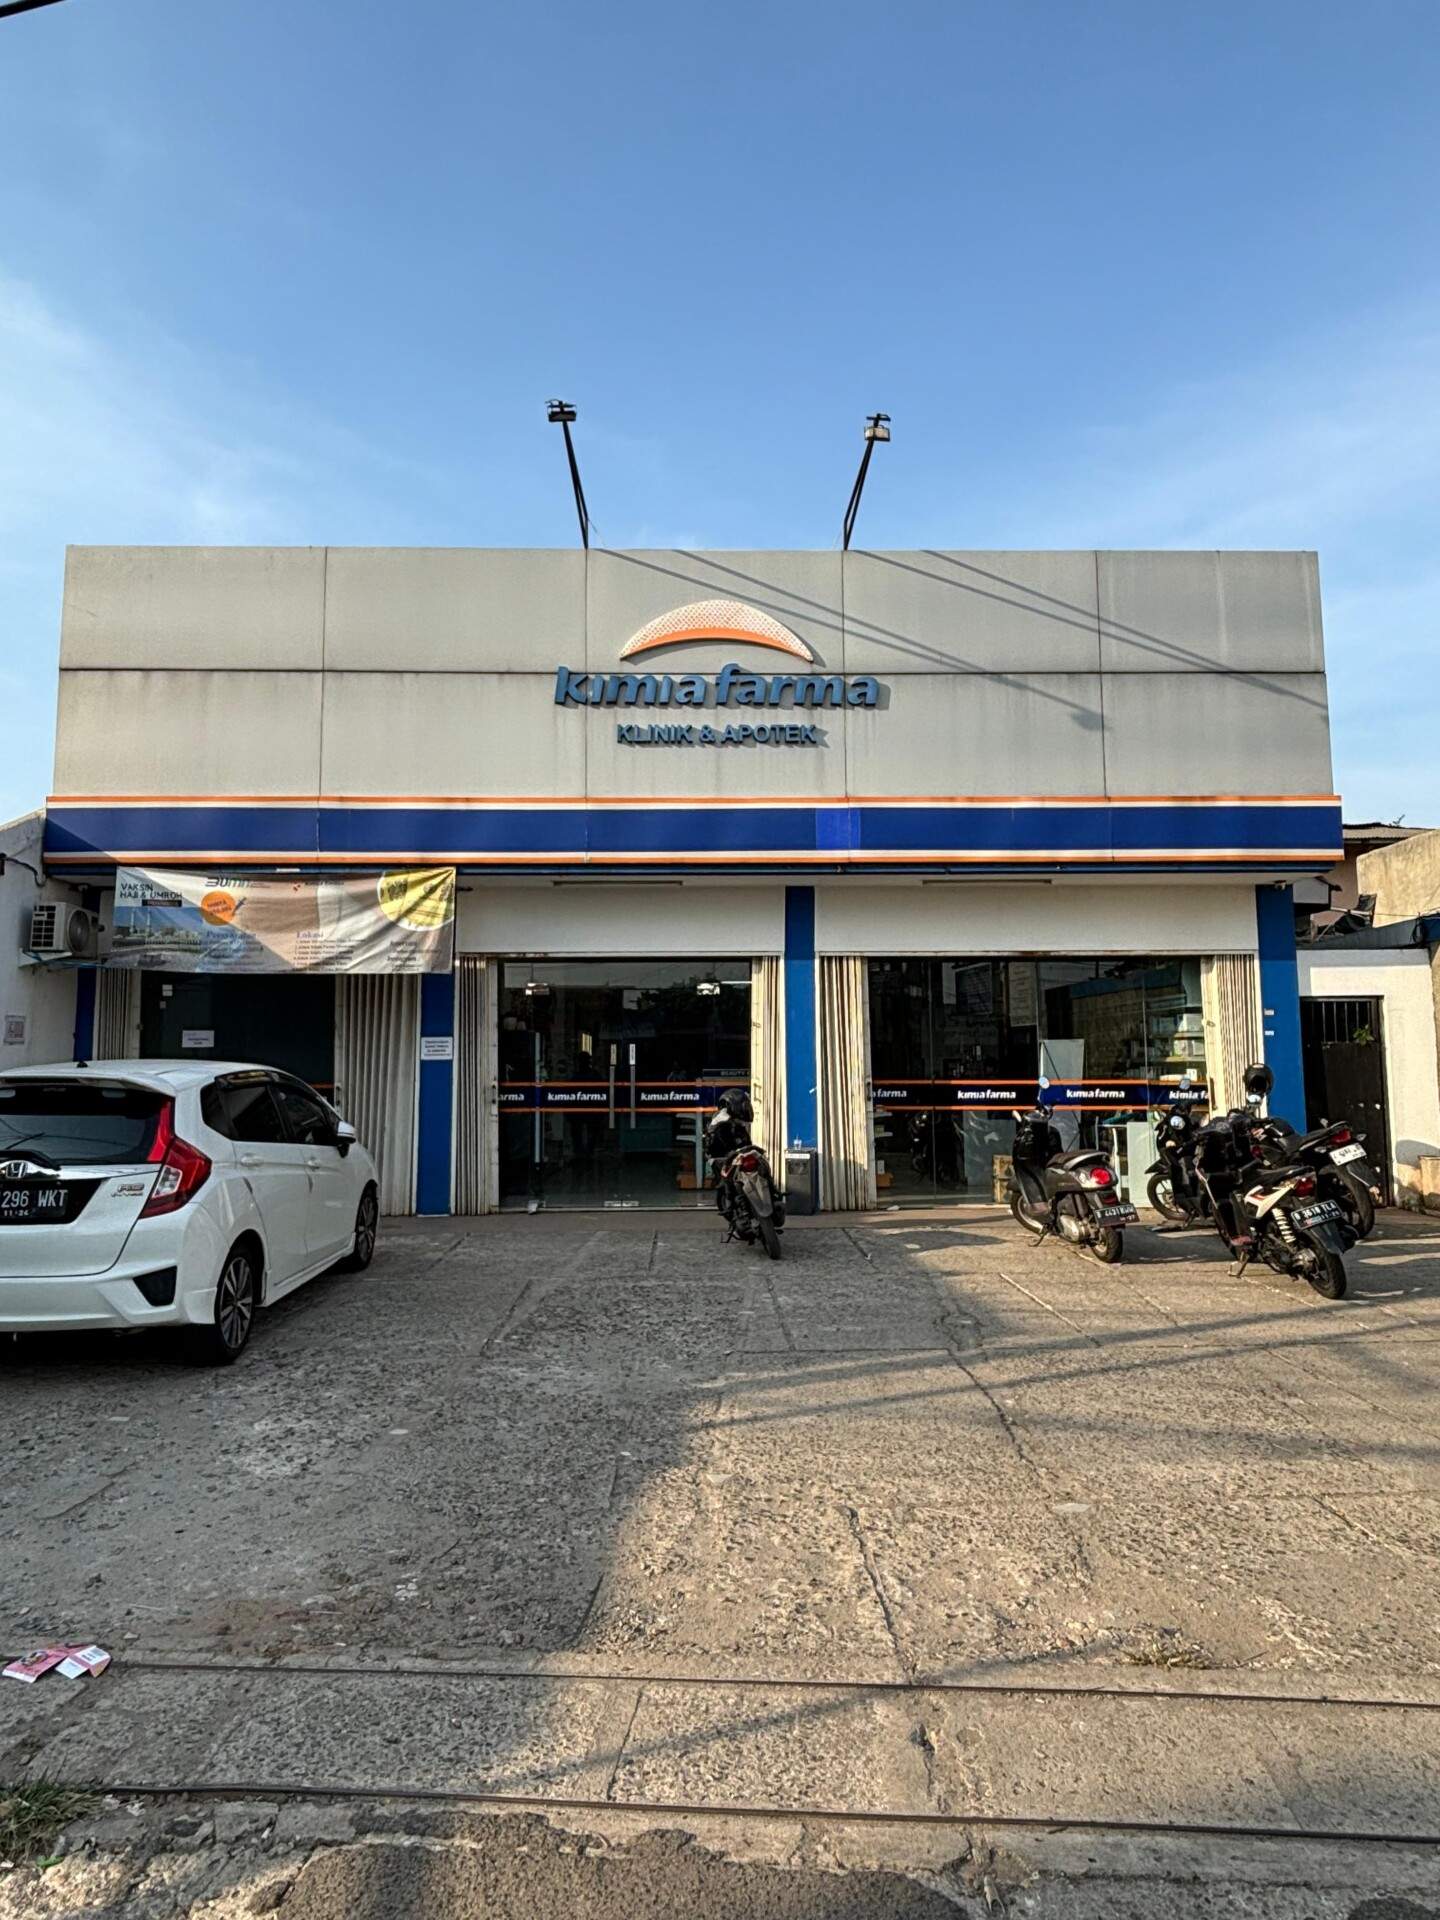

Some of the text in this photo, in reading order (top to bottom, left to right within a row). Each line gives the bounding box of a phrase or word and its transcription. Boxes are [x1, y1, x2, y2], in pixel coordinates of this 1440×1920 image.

[554, 663, 881, 707] kimia farma
[617, 724, 816, 744] KLINIK & APOTEK
[121, 883, 153, 891] VAKSIN
[547, 1091, 607, 1101] kimia farma
[640, 1091, 700, 1101] kimia farma
[877, 1088, 907, 1097] farma
[957, 1090, 1016, 1100] kimia farma
[1066, 1089, 1126, 1099] kimia farma
[1169, 1091, 1198, 1100] kimia
[38, 1189, 68, 1208] WKT
